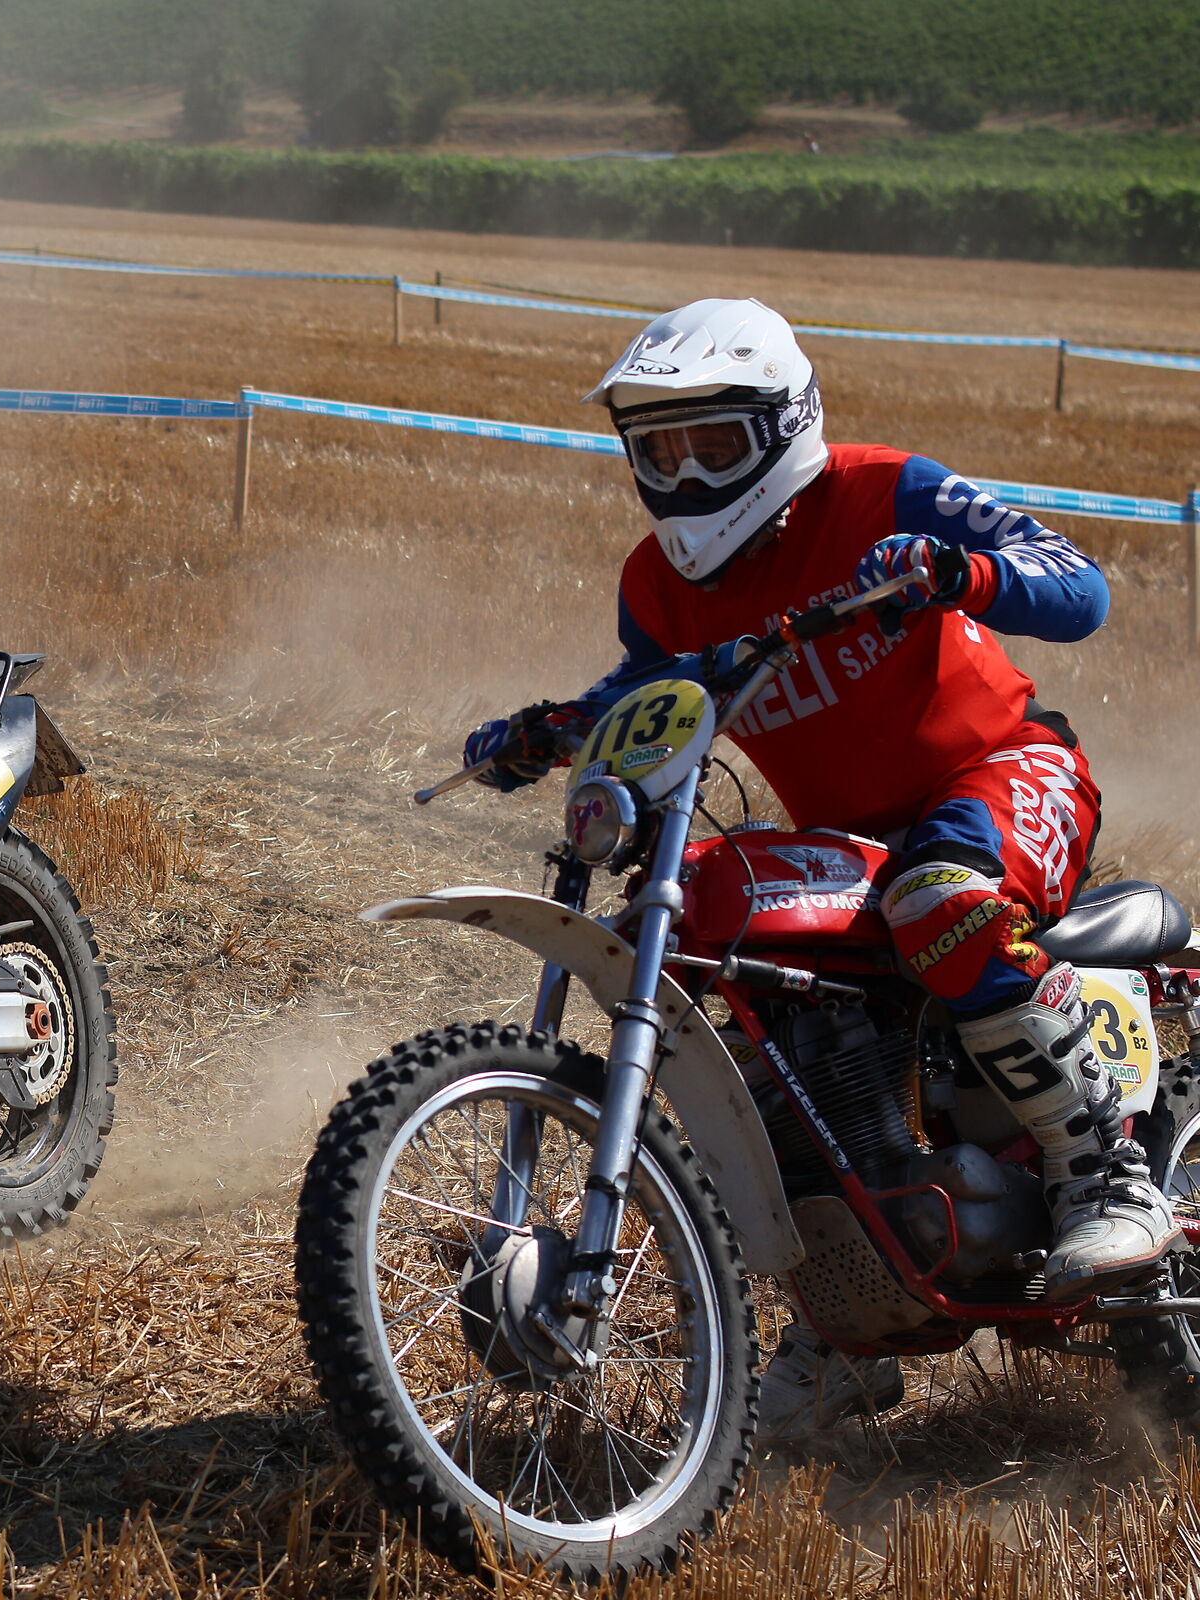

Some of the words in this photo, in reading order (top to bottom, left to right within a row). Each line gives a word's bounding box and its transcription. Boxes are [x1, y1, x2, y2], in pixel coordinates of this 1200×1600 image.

[24, 395, 50, 406] BUTTI
[78, 398, 105, 408] BUTTI
[132, 400, 158, 411] BUTTI
[264, 398, 285, 407] BUTTI
[186, 402, 212, 413] BUTTI
[306, 404, 327, 413] BUTTI
[348, 409, 370, 418] BUTTI
[392, 415, 414, 425] BUTTI
[435, 420, 457, 431] BUTTI
[479, 425, 502, 436] BUTTI
[525, 431, 548, 443] BUTTI
[572, 436, 595, 449] BUTTI
[676, 717, 696, 728] B2
[588, 694, 678, 765] 113
[624, 747, 665, 767] ORAM
[752, 893, 828, 913] MOTO
[829, 893, 882, 912] MOR
[1133, 1036, 1149, 1051] B2
[764, 1040, 837, 1149] METZELER
